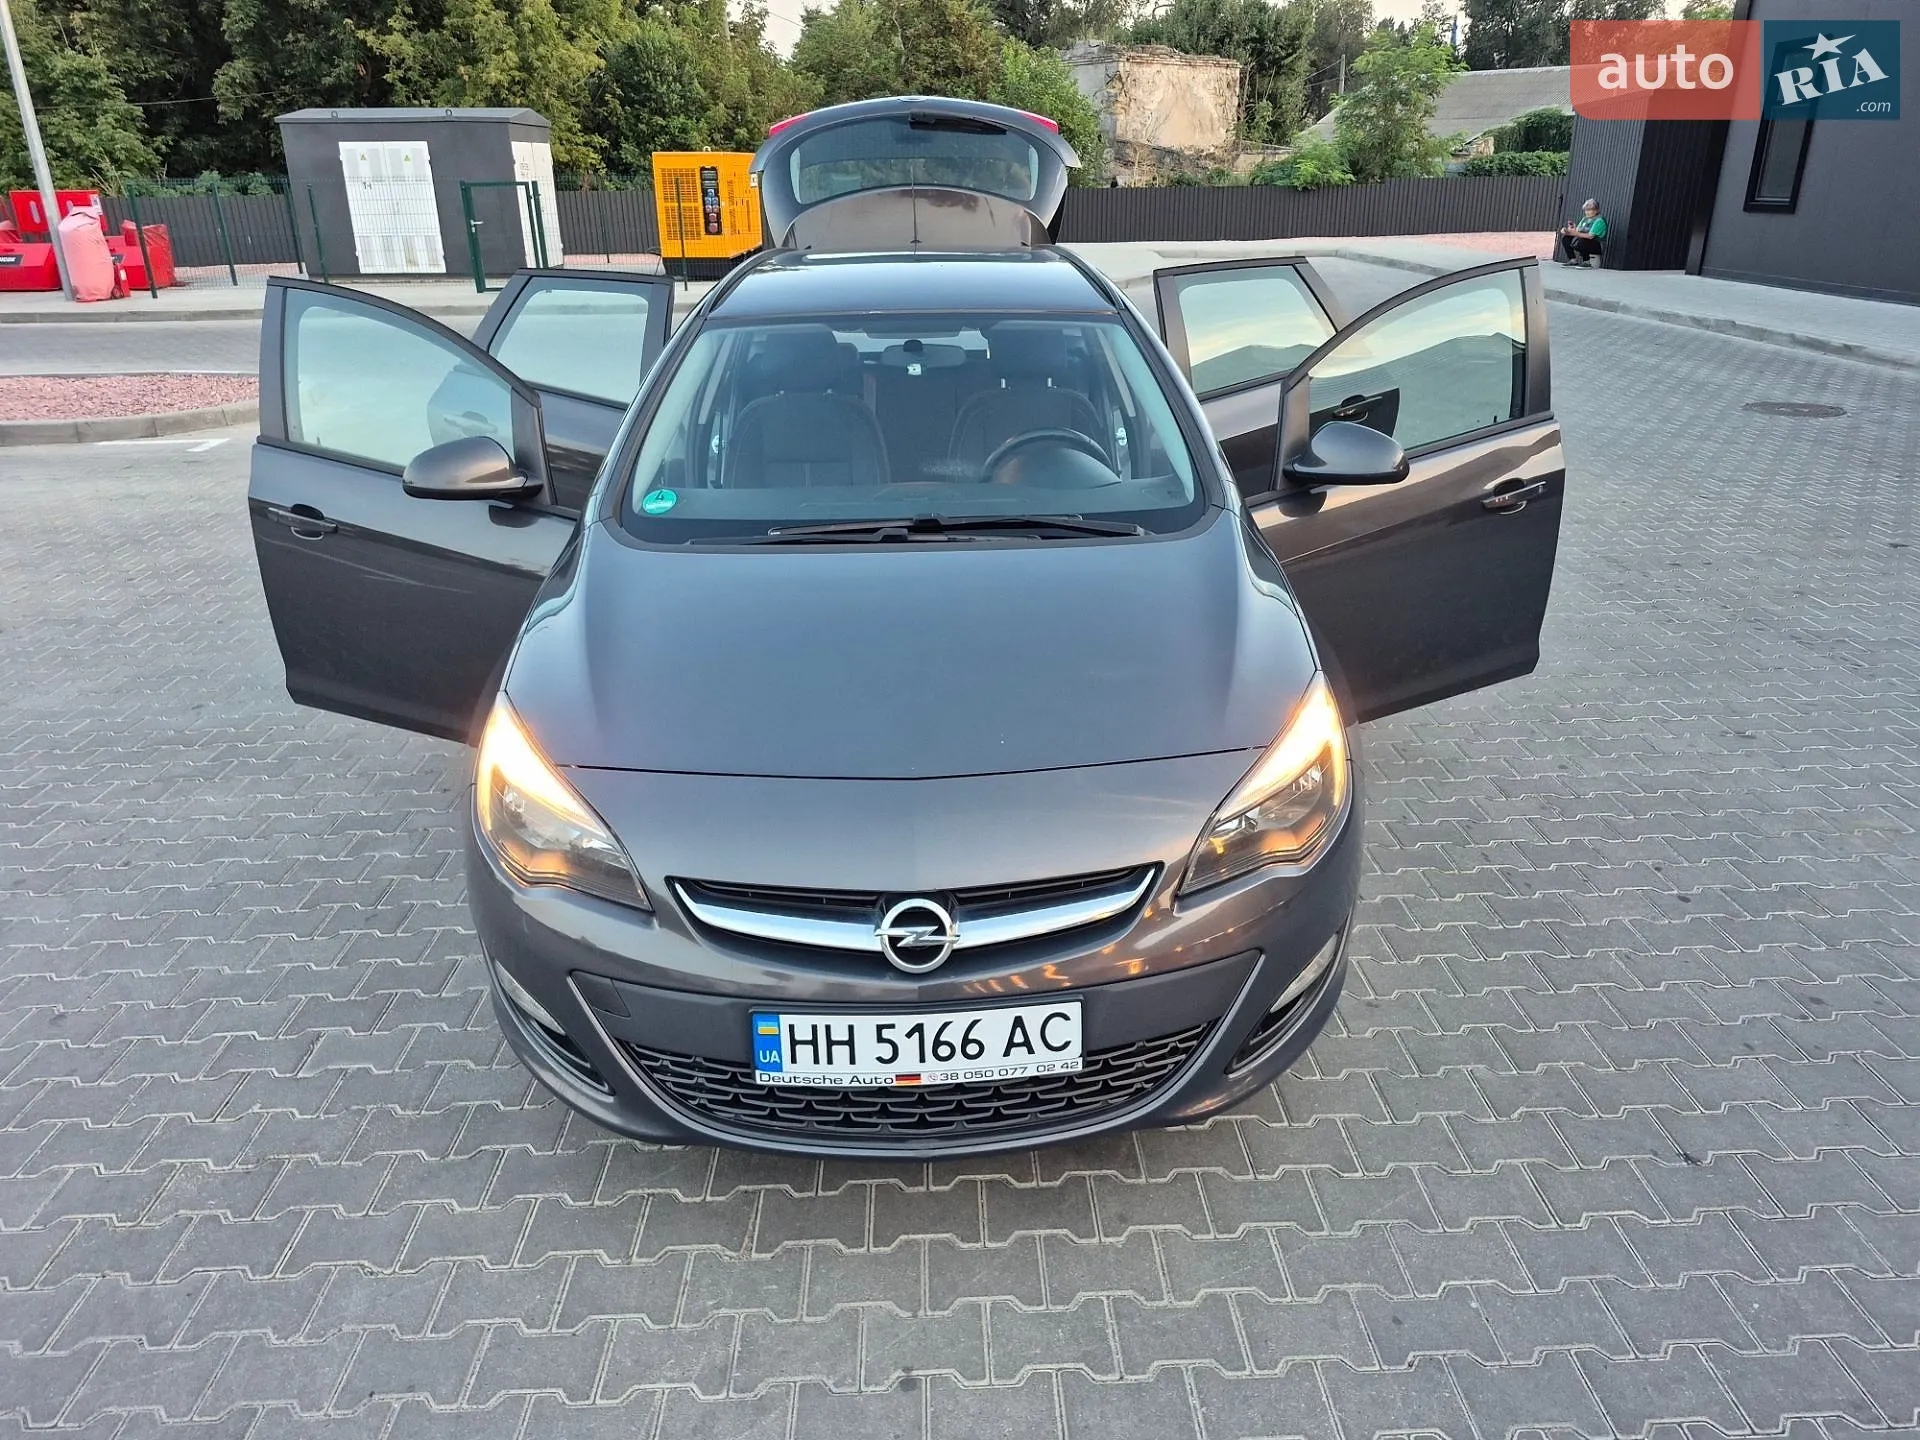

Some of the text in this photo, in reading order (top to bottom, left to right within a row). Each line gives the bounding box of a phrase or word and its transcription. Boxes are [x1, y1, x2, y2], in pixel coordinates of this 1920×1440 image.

[655, 490, 665, 501] 4
[788, 1012, 1072, 1066] HH 5166 AC
[759, 1052, 780, 1064] UA
[759, 1072, 844, 1085] Deutsche
[849, 1075, 894, 1085] Auto
[963, 1069, 994, 1080] 050
[998, 1066, 1028, 1077] 077
[1036, 1063, 1056, 1073] 02
[1060, 1061, 1080, 1070] 42
